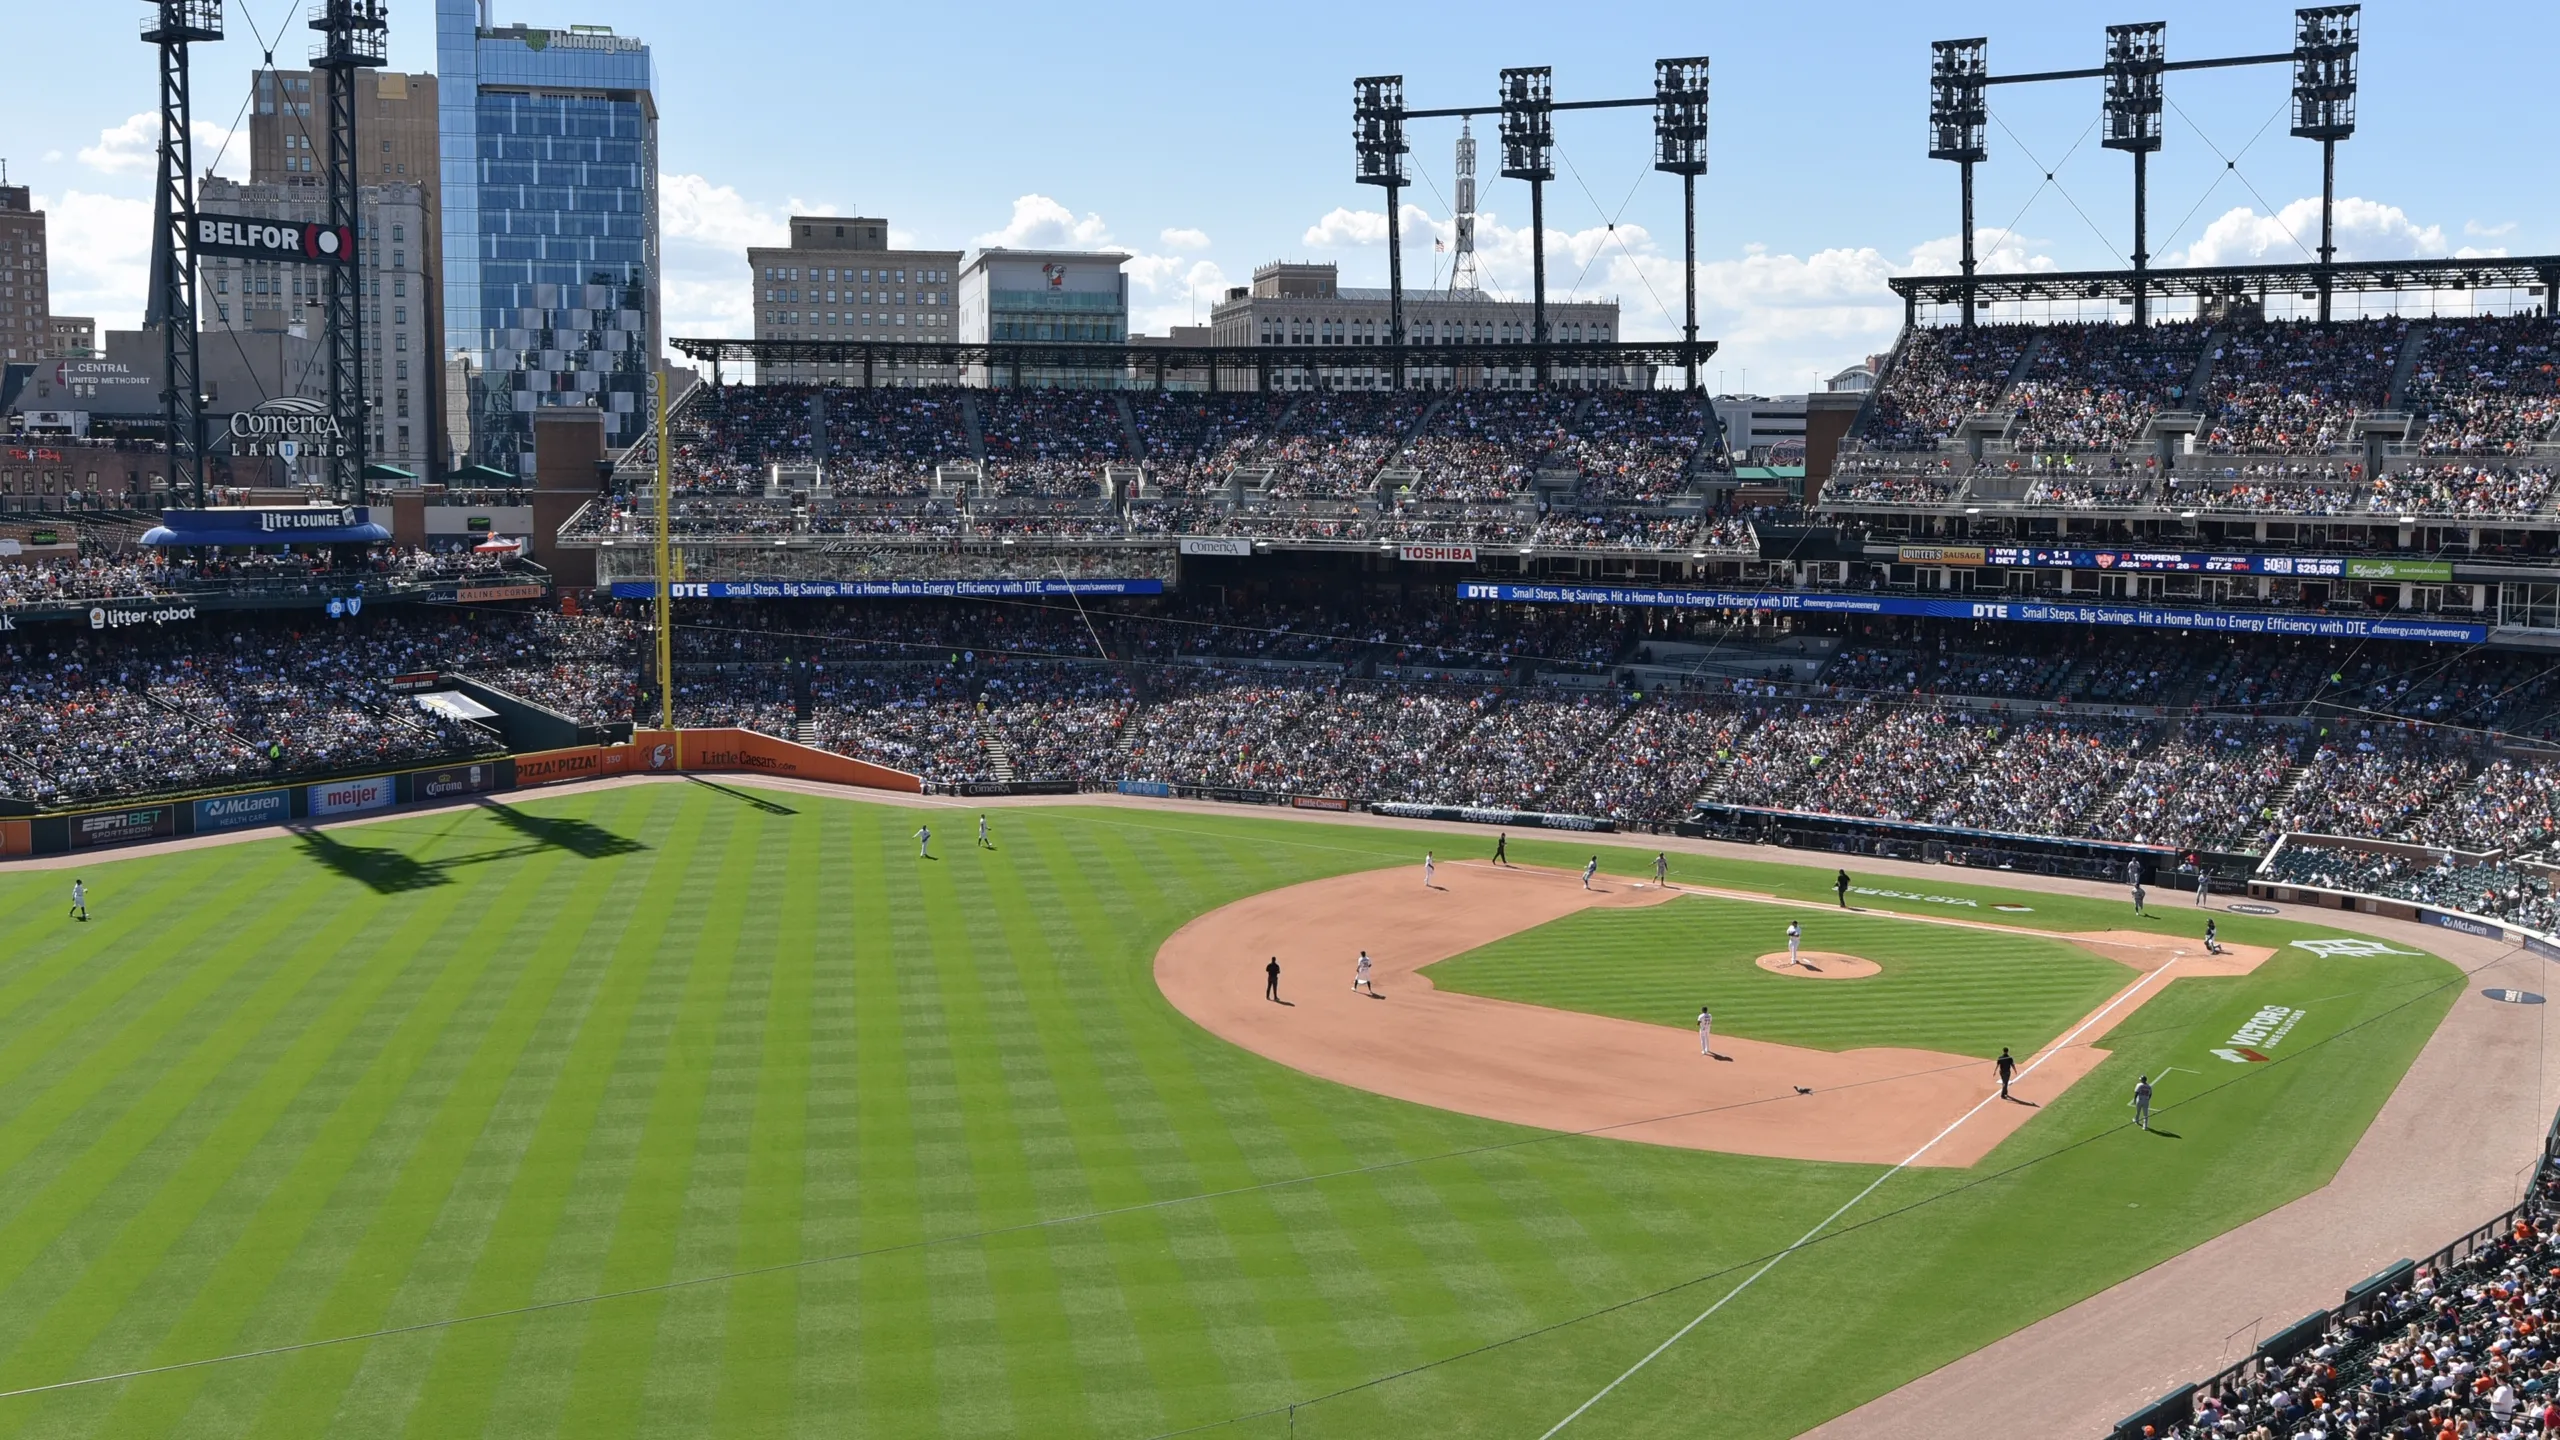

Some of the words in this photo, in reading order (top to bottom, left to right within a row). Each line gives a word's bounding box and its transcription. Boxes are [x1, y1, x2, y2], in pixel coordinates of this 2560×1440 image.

[550, 31, 641, 54] Huntington
[199, 220, 299, 250] BELFOR
[78, 363, 130, 373] CENTRAL
[231, 443, 344, 457] LANDING
[260, 512, 291, 532] Lite
[294, 514, 339, 527] LOUNGE
[912, 544, 949, 555] TIGER
[962, 544, 991, 555] CLUB
[1403, 547, 1473, 560] TOSHIBA
[1902, 549, 1942, 560] WINTER'S
[1943, 551, 1981, 560] SAUSAGE
[1995, 548, 2017, 556] NYM
[2053, 550, 2070, 559] 1-1
[2133, 554, 2181, 562] TORRENS
[2206, 562, 2232, 570] 87.2
[2297, 564, 2340, 575] $29,596
[504, 587, 538, 597] CORNER
[672, 584, 709, 597] DTE
[725, 583, 751, 595] Small
[753, 583, 782, 596] Steps,
[784, 583, 799, 597] Big
[800, 583, 838, 597] Savings.
[840, 583, 854, 594] Hit
[856, 585, 862, 594] a
[863, 583, 890, 594] Home
[892, 582, 910, 594] Run
[912, 583, 921, 594] to
[924, 582, 954, 596] Energy
[957, 581, 1000, 595] Efficiency
[1002, 581, 1022, 593] with
[1025, 581, 1044, 593] DTE.
[1468, 585, 1498, 598] DTE
[1512, 587, 1534, 598] Small
[1535, 588, 1560, 601] Steps,
[1561, 588, 1575, 602] Big
[1576, 589, 1609, 603] Savings.
[1611, 591, 1623, 602] Hit
[1625, 594, 1630, 602] a
[1632, 592, 1656, 603] Home
[1657, 592, 1674, 604] Run
[1675, 594, 1685, 604] to
[1686, 593, 1715, 607] Energy
[1718, 594, 1758, 608] Efficiency
[1760, 595, 1781, 607] with
[1782, 596, 1802, 608] DTE.
[1972, 604, 2008, 618] DTE
[2022, 606, 2048, 618] Small
[2050, 607, 2078, 622] Steps,
[2080, 608, 2096, 623] Big
[2097, 609, 2136, 624] Savings.
[2139, 611, 2153, 623] Hit
[2155, 614, 2161, 624] a
[2164, 613, 2192, 625] Home
[2194, 614, 2214, 626] Run
[2216, 615, 2227, 627] to
[2229, 616, 2264, 632] Energy
[2267, 617, 2317, 634] Efficiency
[2320, 621, 2343, 634] with
[2346, 621, 2369, 635] DTE.
[702, 750, 738, 765] Little
[516, 760, 555, 777] PIZZA!
[558, 755, 597, 773] PIZZA!
[426, 780, 462, 796] Corona
[327, 784, 377, 807] meijer
[226, 796, 279, 814] McLaren
[1298, 797, 1316, 807] Little
[1316, 799, 1342, 809] Caesars
[82, 814, 128, 832] ESPN
[128, 810, 162, 826] BET
[220, 814, 247, 826] HEALTH
[248, 812, 267, 822] CARE
[92, 825, 154, 839] SPORTSBOOK
[2452, 920, 2487, 936] McLaren
[2225, 1005, 2290, 1046] VICTORS
